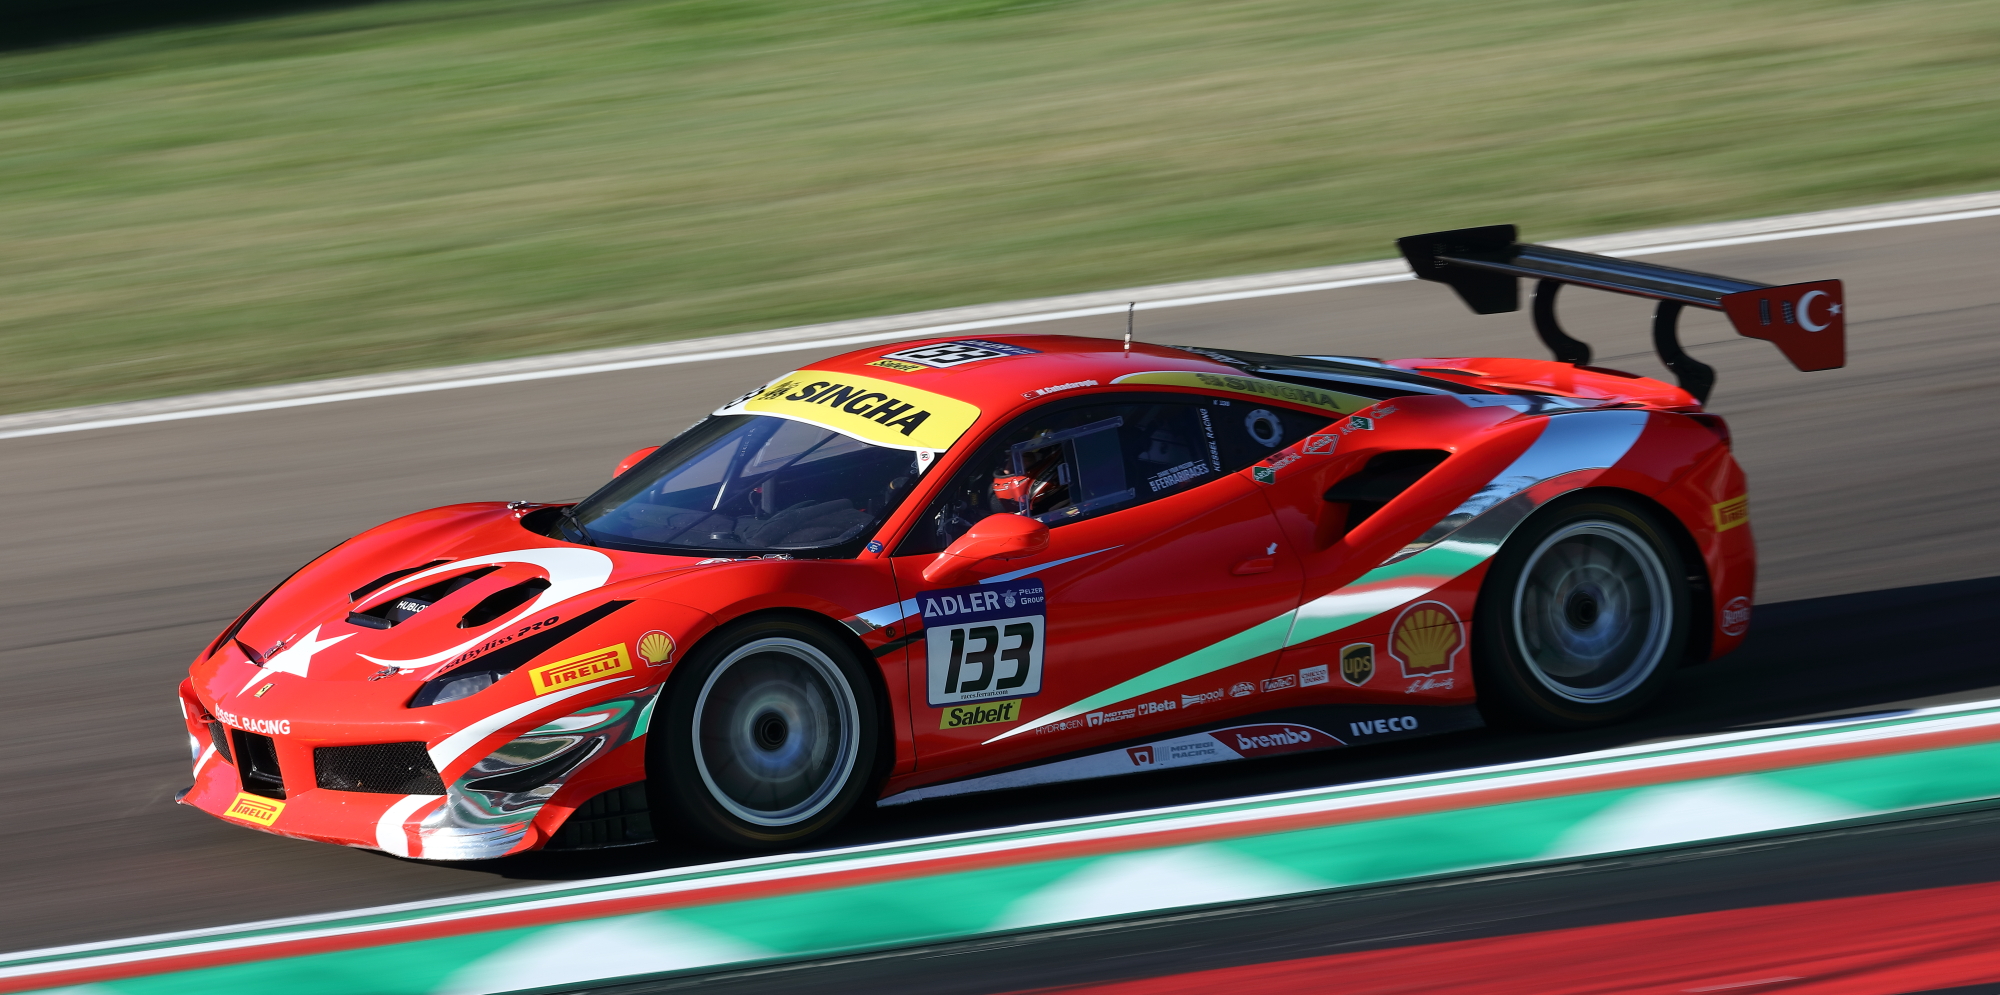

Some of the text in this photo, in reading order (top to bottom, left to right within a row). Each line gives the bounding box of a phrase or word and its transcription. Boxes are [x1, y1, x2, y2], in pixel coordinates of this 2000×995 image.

[1222, 376, 1340, 410] SINGHA
[785, 381, 932, 437] SINGHA
[1200, 408, 1221, 472] KESSEL RACING
[1018, 587, 1043, 596] PELZER
[1020, 596, 1045, 605] GROUP
[396, 600, 429, 613] HUBLO
[924, 590, 1001, 618] ADLER
[517, 615, 560, 637] PRO
[541, 650, 621, 688] PIRELLI
[944, 622, 1035, 694] 133
[1344, 655, 1371, 679] ups
[960, 688, 1009, 700] races.ferrari.com
[948, 703, 1013, 727] Sabelt
[1104, 708, 1136, 718] MOTEGI
[1148, 700, 1177, 713] Beta
[242, 717, 291, 735] RACING
[1036, 719, 1083, 735] HYDROGEN
[1103, 713, 1136, 723] RACING
[1350, 715, 1418, 737] IVECO
[1170, 741, 1214, 753] MOTEGI
[1237, 728, 1312, 750] brembo
[1170, 747, 1216, 760] RACING
[231, 798, 278, 821] PIRELLI
